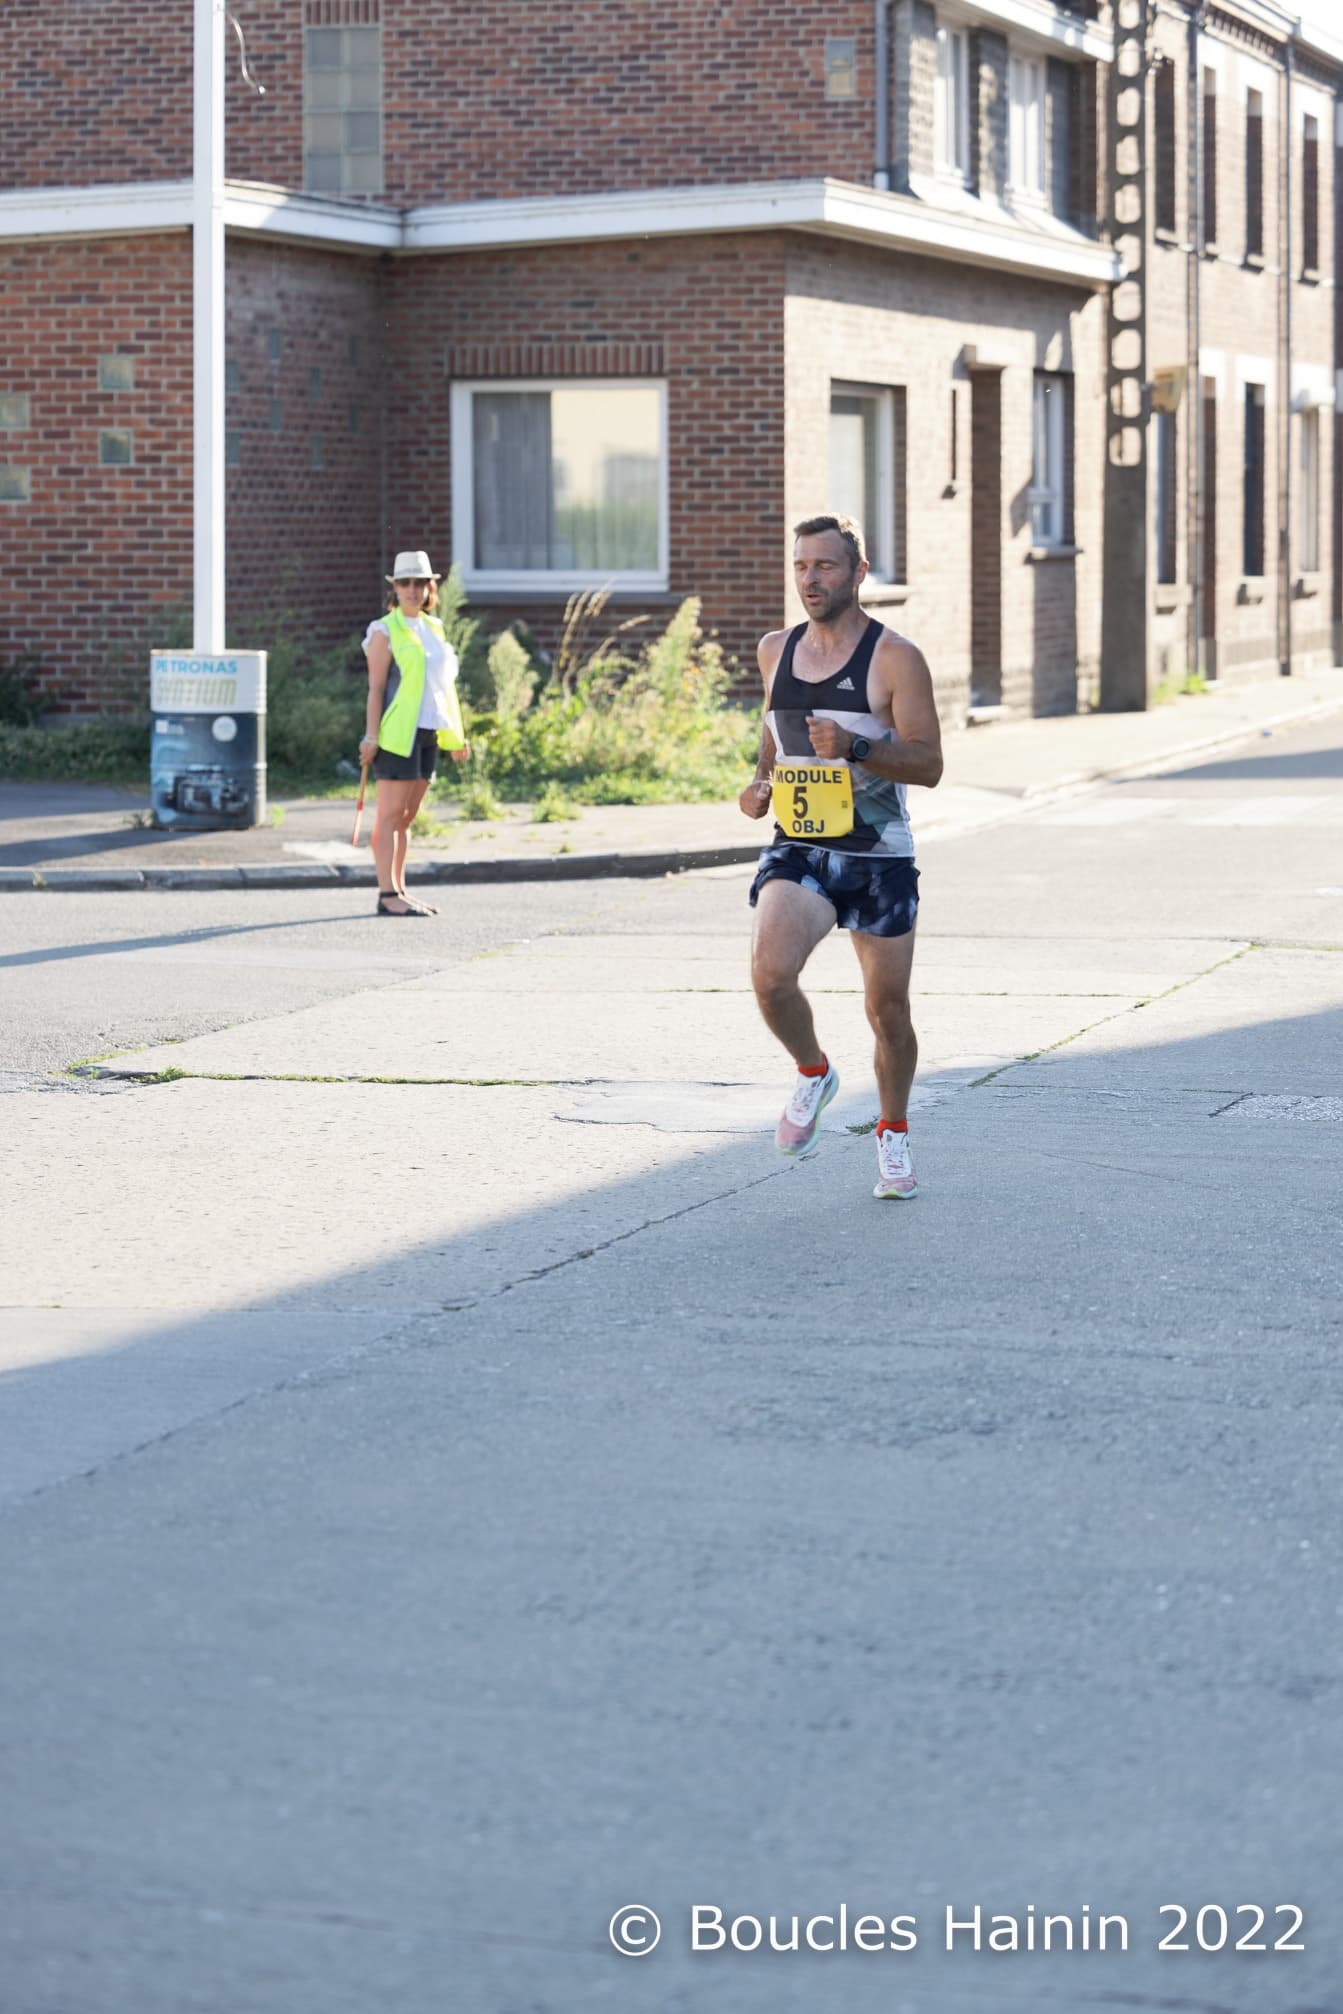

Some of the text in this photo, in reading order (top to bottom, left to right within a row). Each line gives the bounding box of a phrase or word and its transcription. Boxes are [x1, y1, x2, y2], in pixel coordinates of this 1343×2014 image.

[776, 769, 843, 784] MODULE
[793, 785, 808, 819] 5
[792, 819, 825, 834] OBJ
